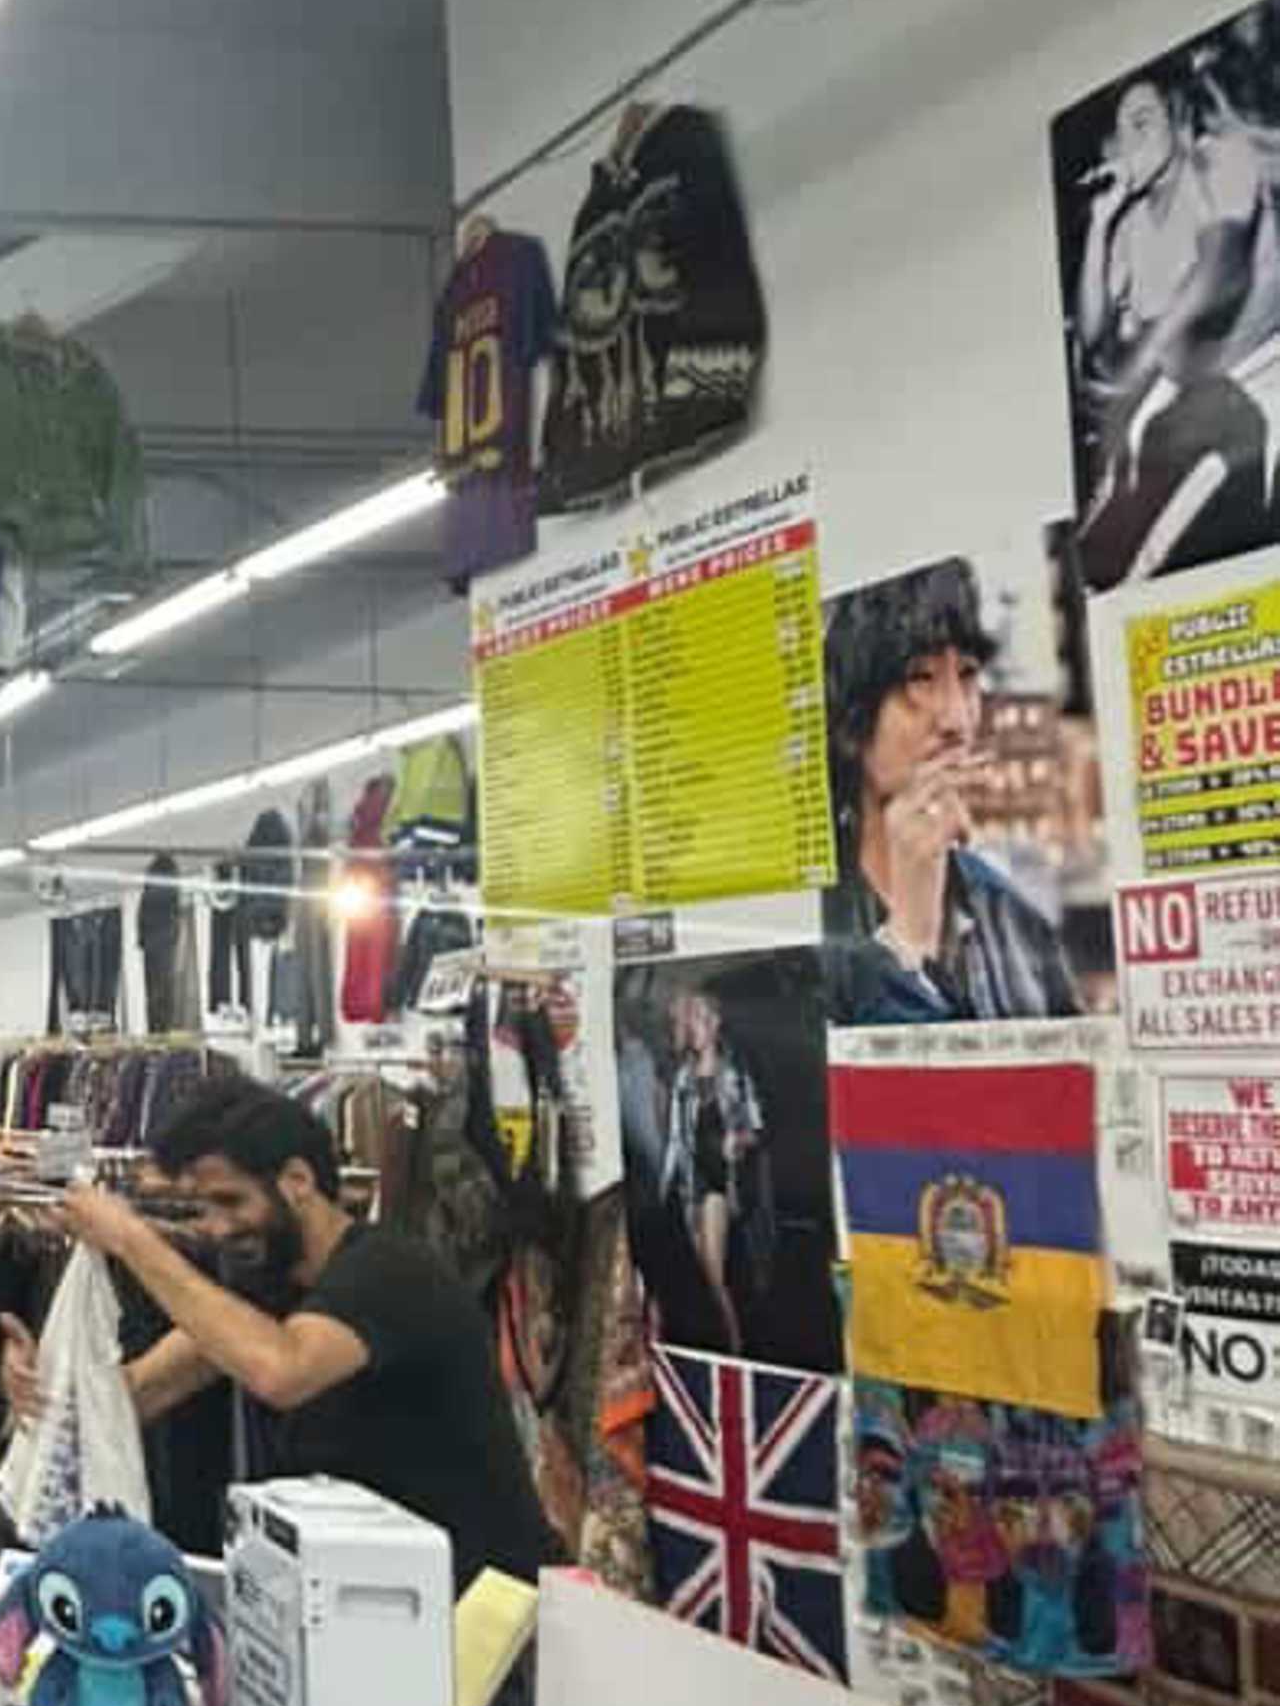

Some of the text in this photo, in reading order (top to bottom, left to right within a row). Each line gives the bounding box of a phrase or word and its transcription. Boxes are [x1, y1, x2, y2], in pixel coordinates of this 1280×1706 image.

[447, 337, 502, 454] 10
[1126, 892, 1192, 955] NO
[1138, 1007, 1178, 1038] ALL
[1184, 1003, 1263, 1036] SALES
[1227, 1077, 1275, 1110] WE
[1180, 1323, 1267, 1384] NO
